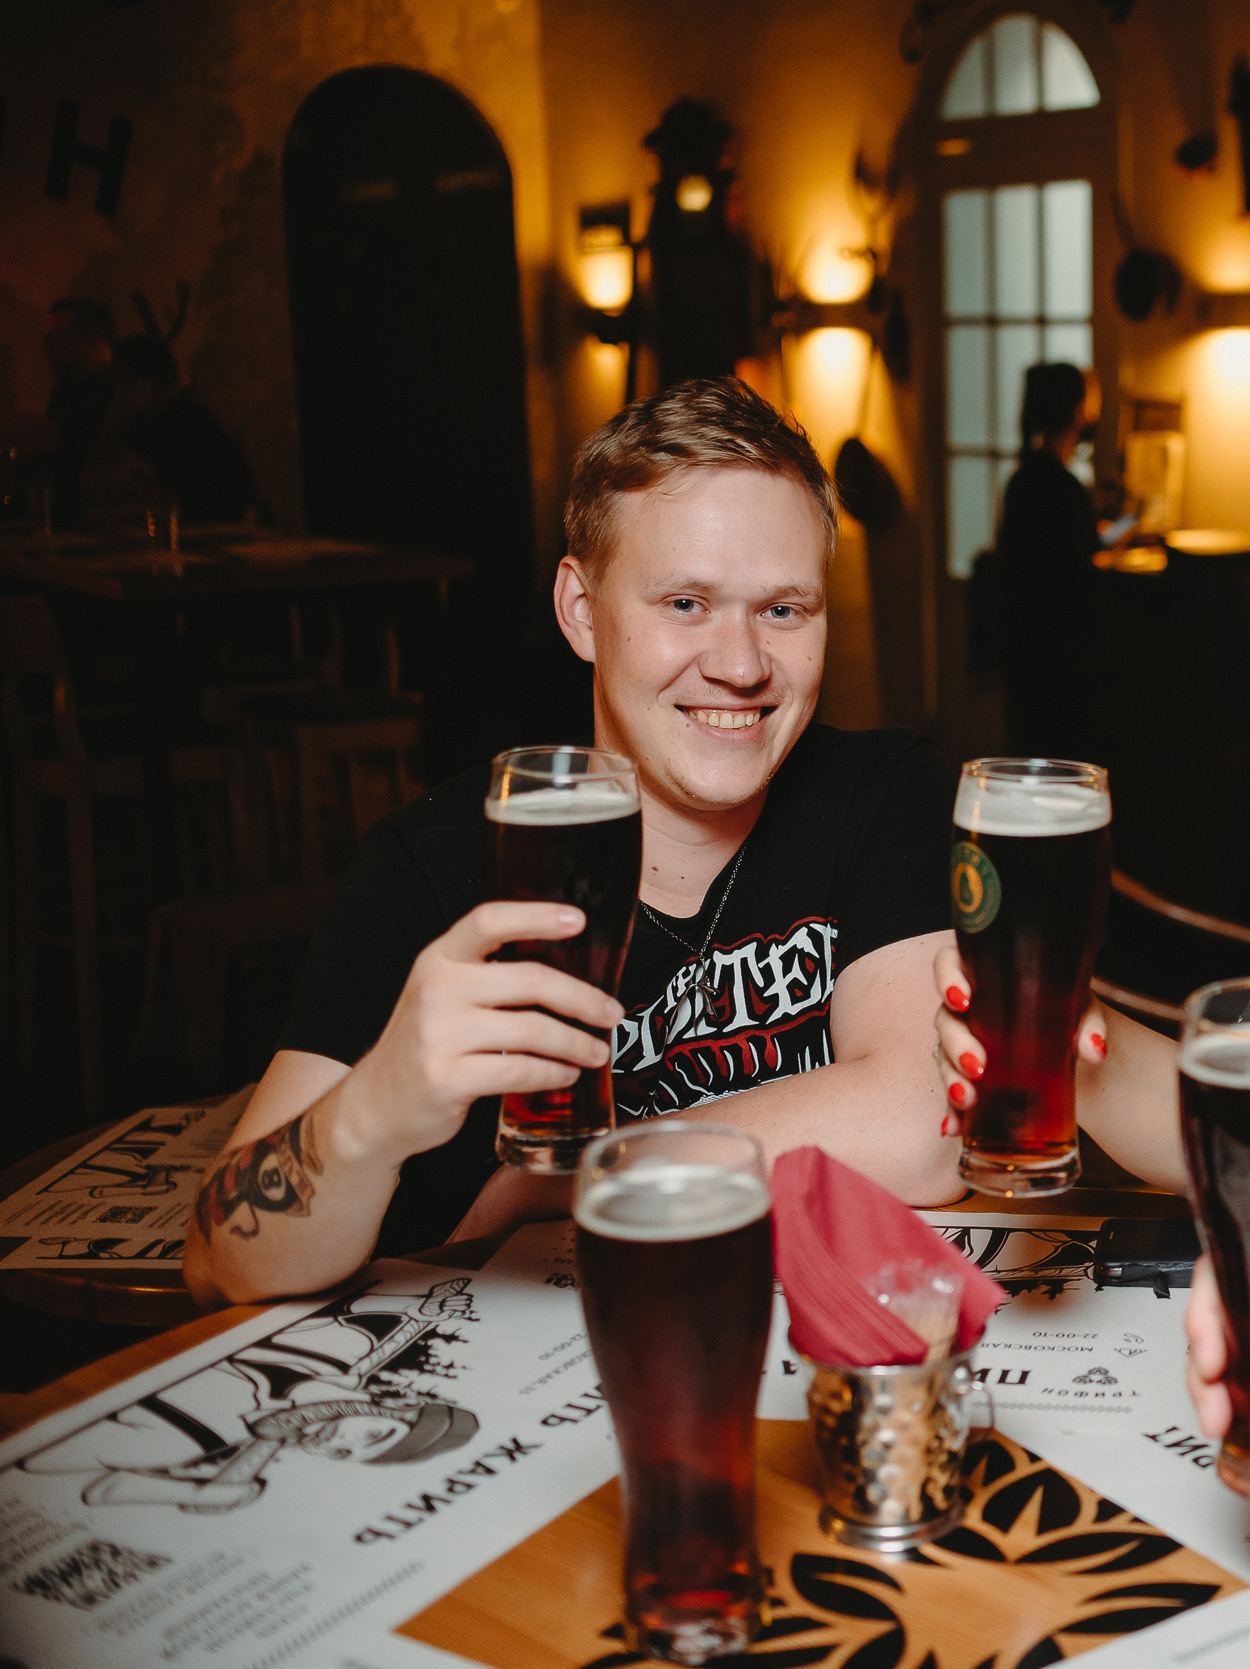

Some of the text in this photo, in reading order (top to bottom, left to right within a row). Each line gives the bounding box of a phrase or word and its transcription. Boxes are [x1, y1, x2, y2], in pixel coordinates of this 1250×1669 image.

[1032, 1331, 1099, 1339] 22-00-10
[1042, 1387, 1141, 1399] ТРИФОН
[354, 1437, 543, 1544] ЖАРИТЬ
